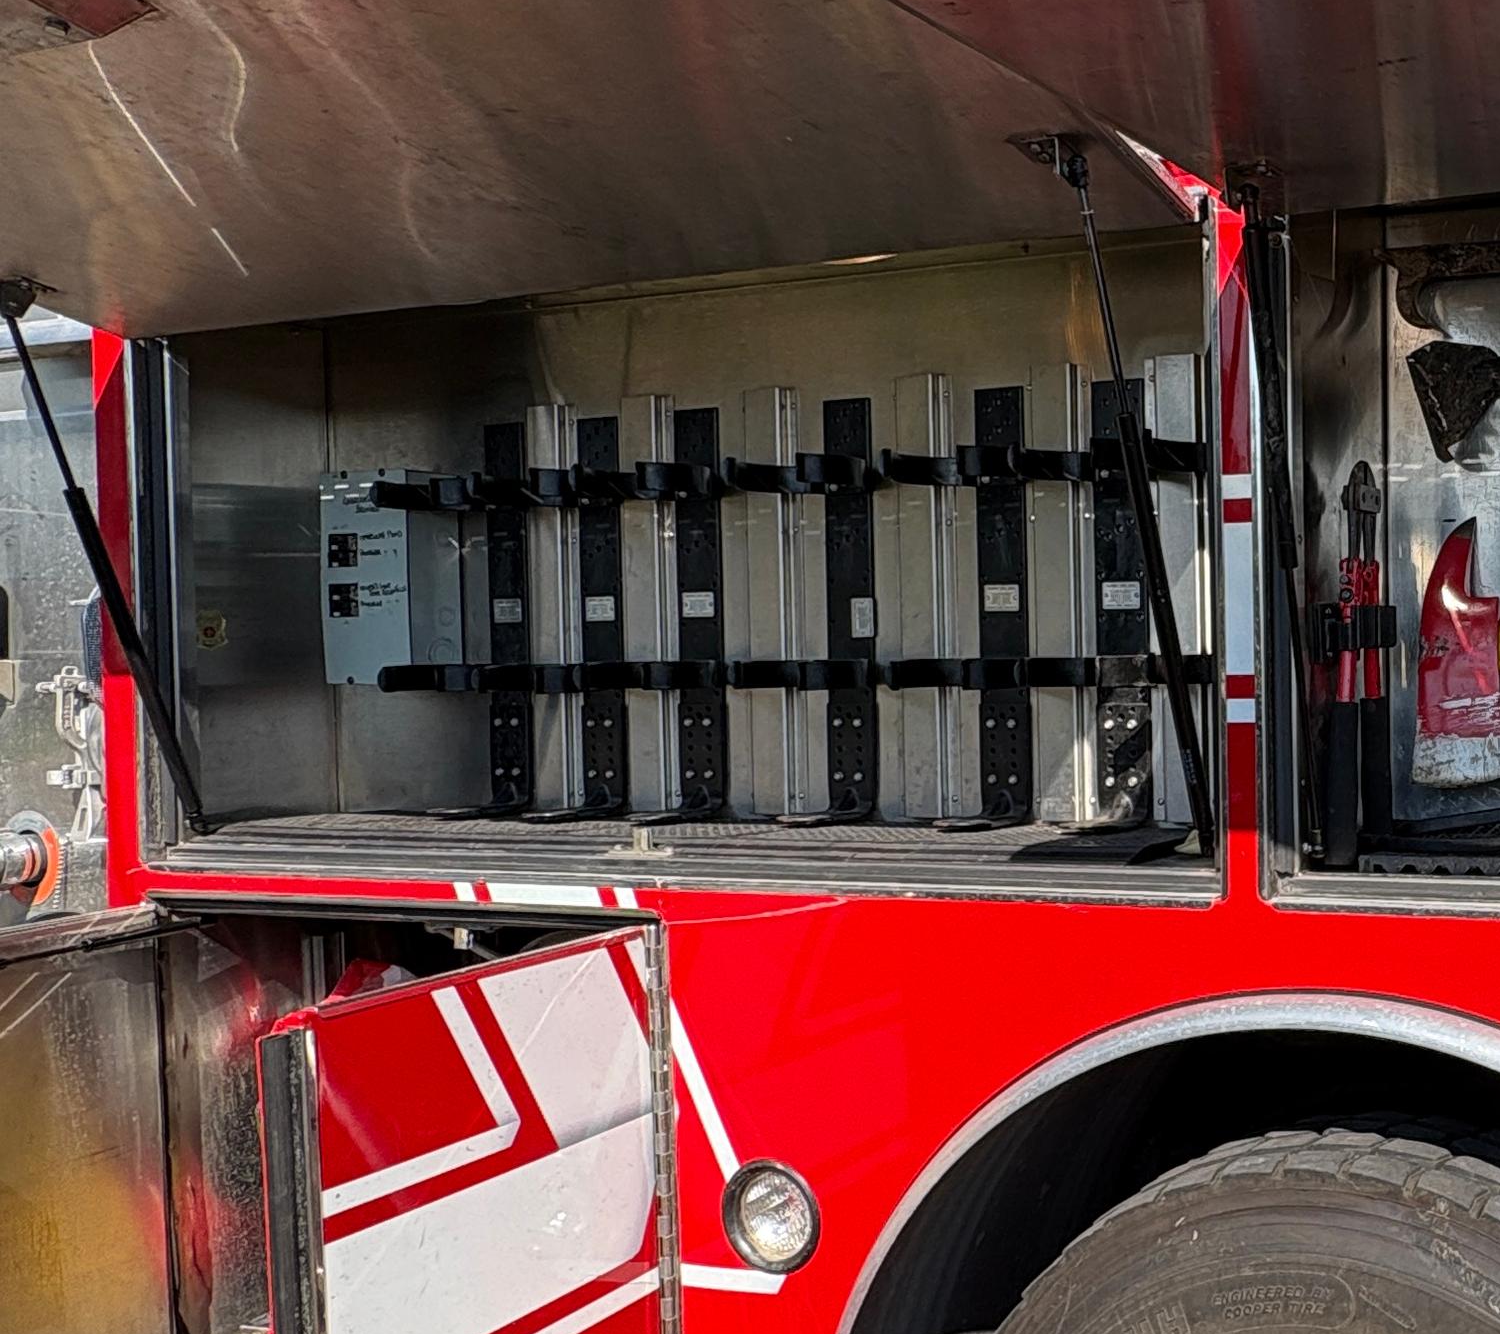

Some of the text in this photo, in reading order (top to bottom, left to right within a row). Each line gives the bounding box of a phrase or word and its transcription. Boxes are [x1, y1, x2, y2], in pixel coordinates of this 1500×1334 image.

[1212, 1284, 1336, 1307] ENGINEERED BY
[1224, 1300, 1327, 1321] COOPER TIRE
